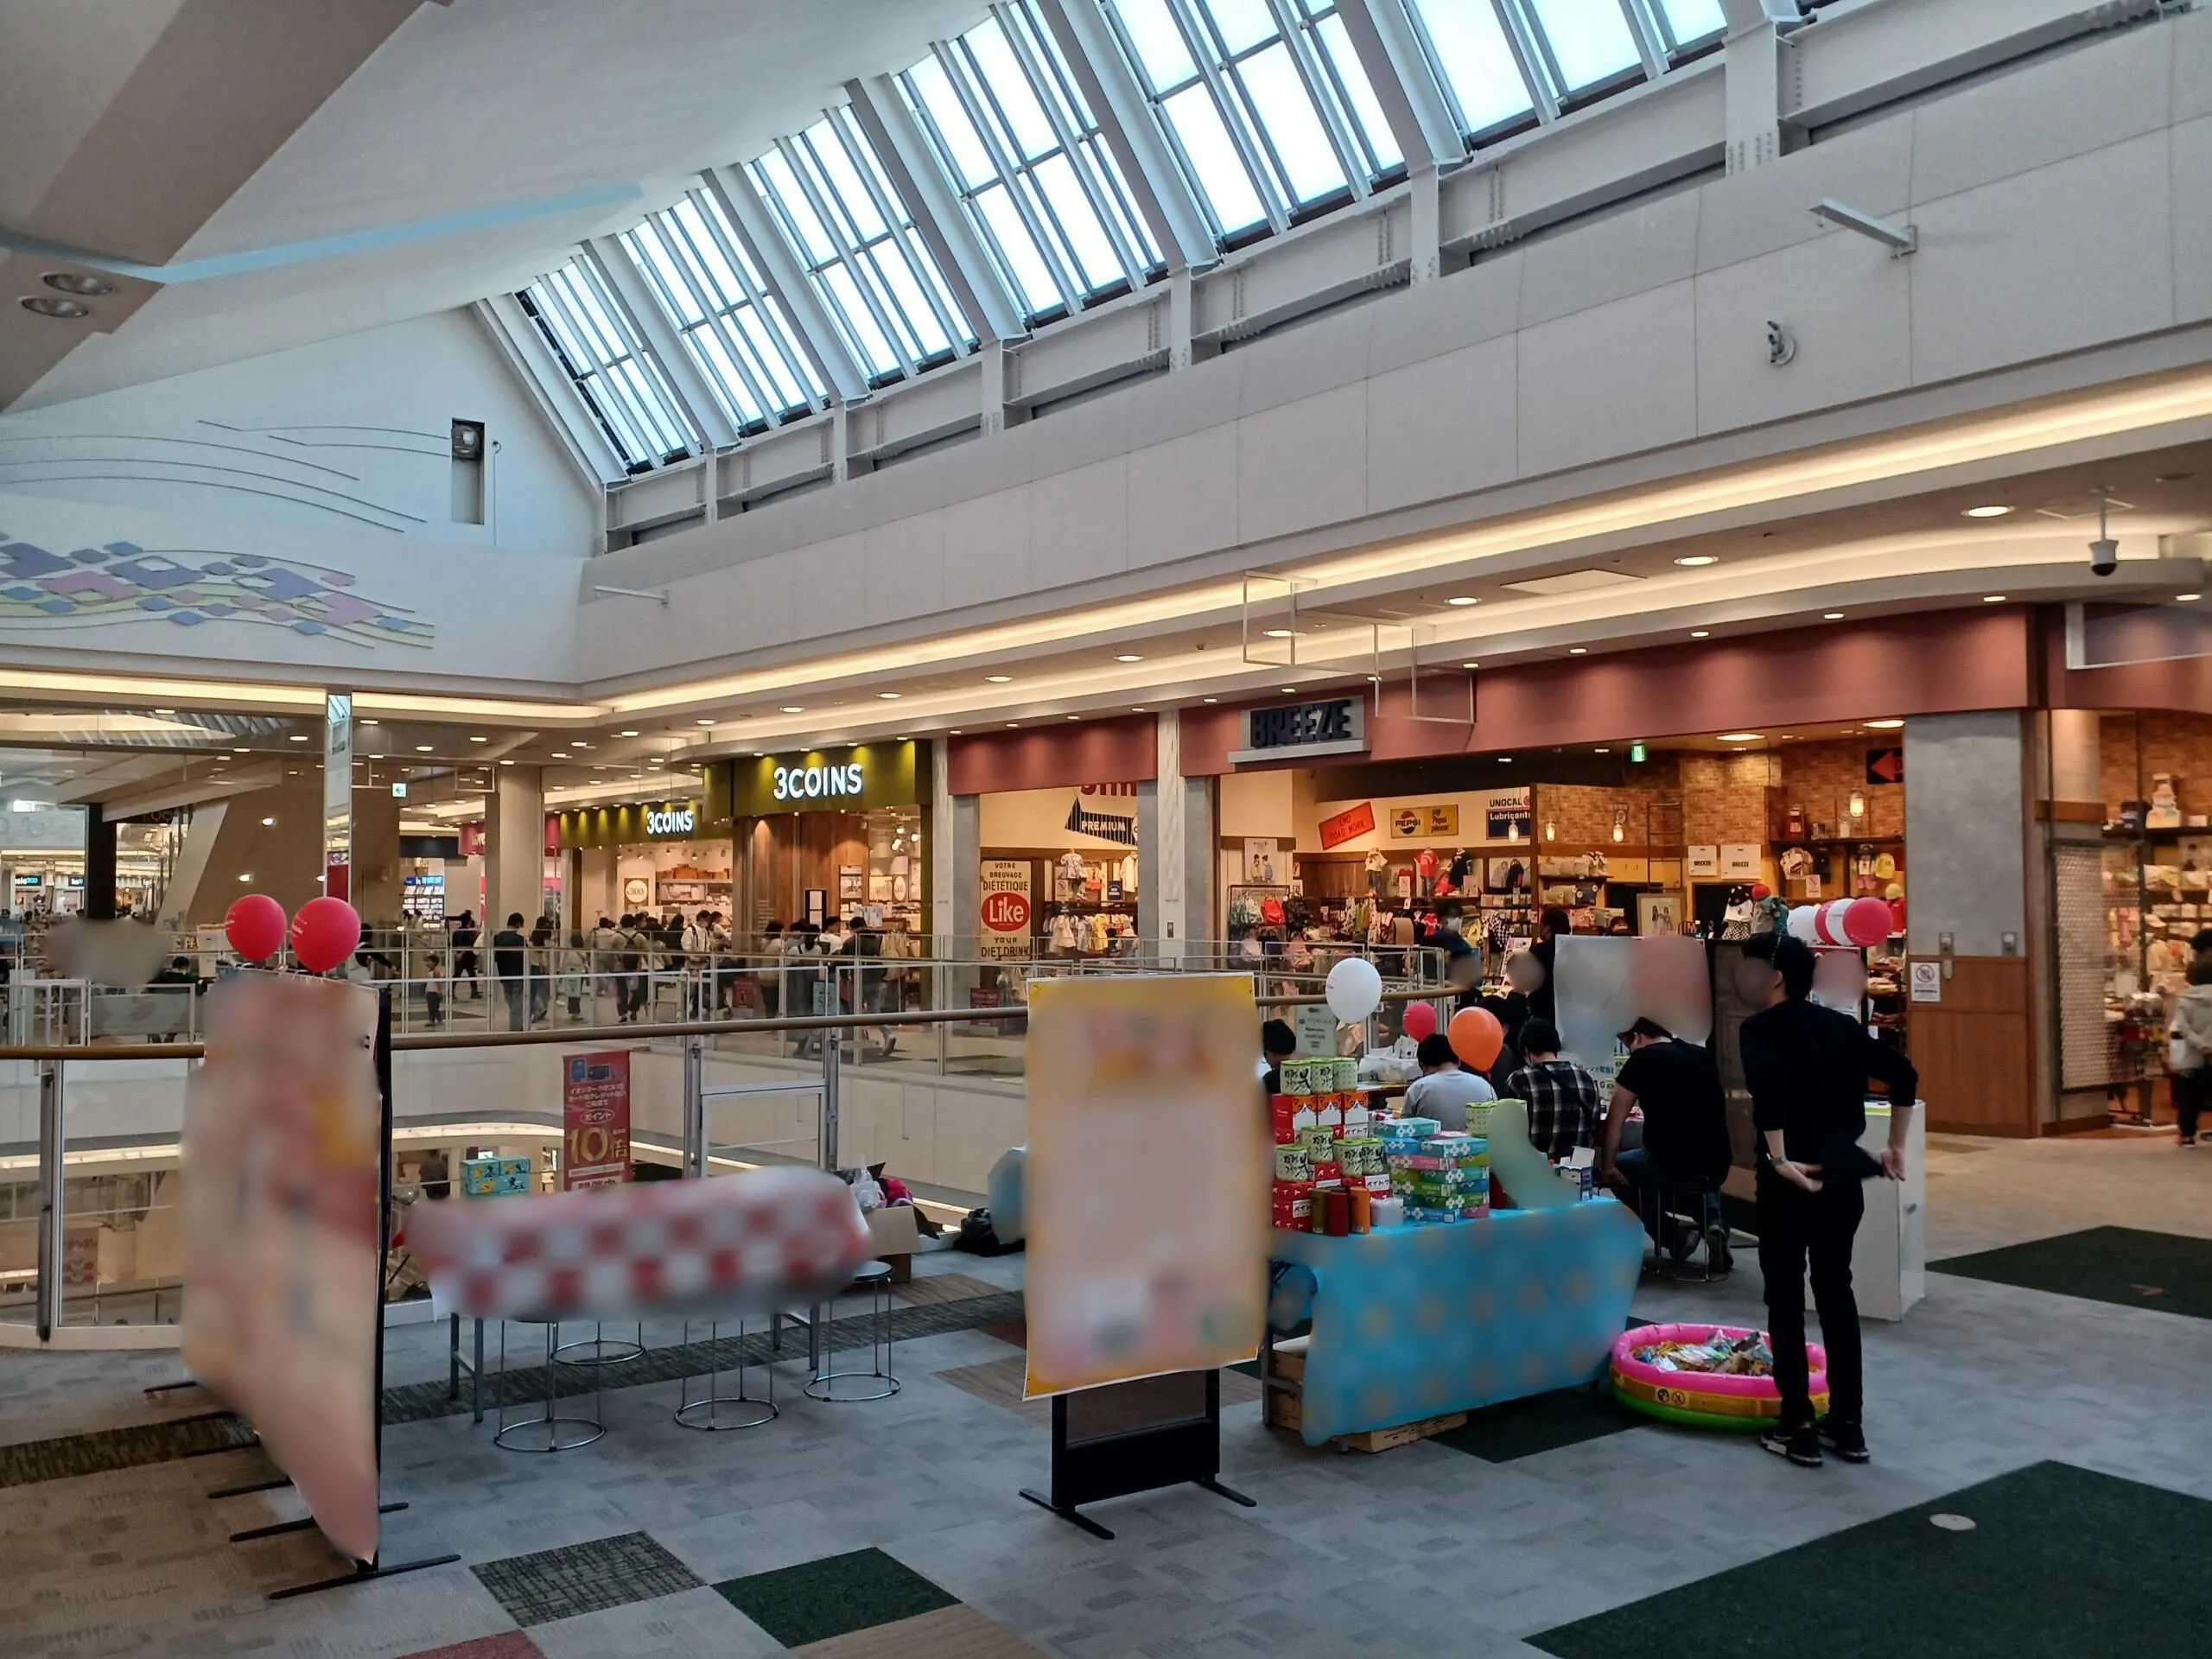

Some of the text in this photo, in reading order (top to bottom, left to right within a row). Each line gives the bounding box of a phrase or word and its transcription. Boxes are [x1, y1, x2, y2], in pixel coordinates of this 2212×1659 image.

[1250, 699, 1352, 748] BREEZE
[773, 763, 863, 799] 3COINS
[1490, 798, 1522, 807] UNOCAL
[646, 810, 694, 835] 3COINS
[1081, 821, 1126, 831] PREMIUM
[988, 896, 1025, 923] Like
[981, 945, 1030, 957] DIET DRINK
